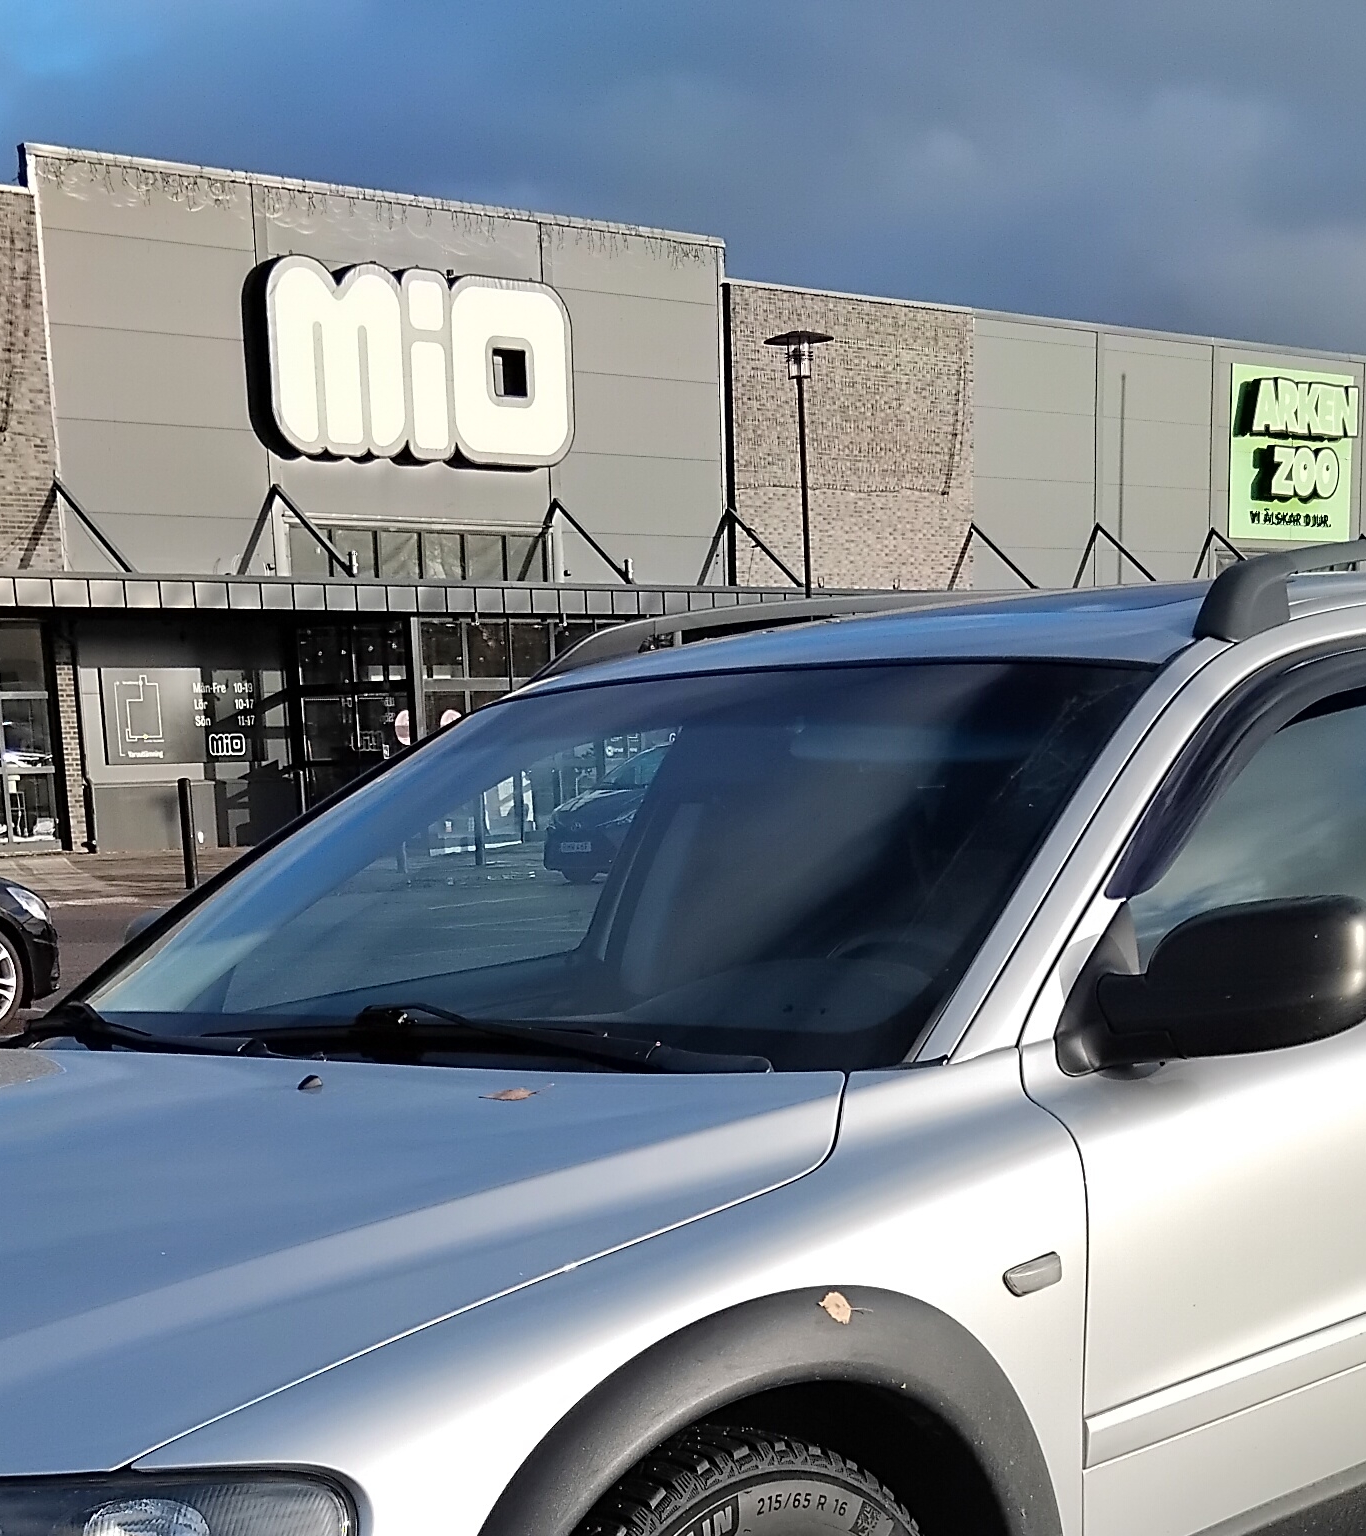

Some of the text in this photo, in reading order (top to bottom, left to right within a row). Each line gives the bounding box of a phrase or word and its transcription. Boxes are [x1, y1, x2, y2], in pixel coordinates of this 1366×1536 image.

[1251, 377, 1359, 437] ARKEN
[1270, 445, 1340, 499] ZOO
[1249, 511, 1261, 525] VI
[1263, 507, 1302, 526] ÄLSKAR
[192, 682, 253, 694] Mån-Fre 10-19
[193, 699, 254, 710] Lör 10-17
[195, 715, 255, 727] Sön 11-17
[757, 1491, 849, 1517] 215/65 R 16
